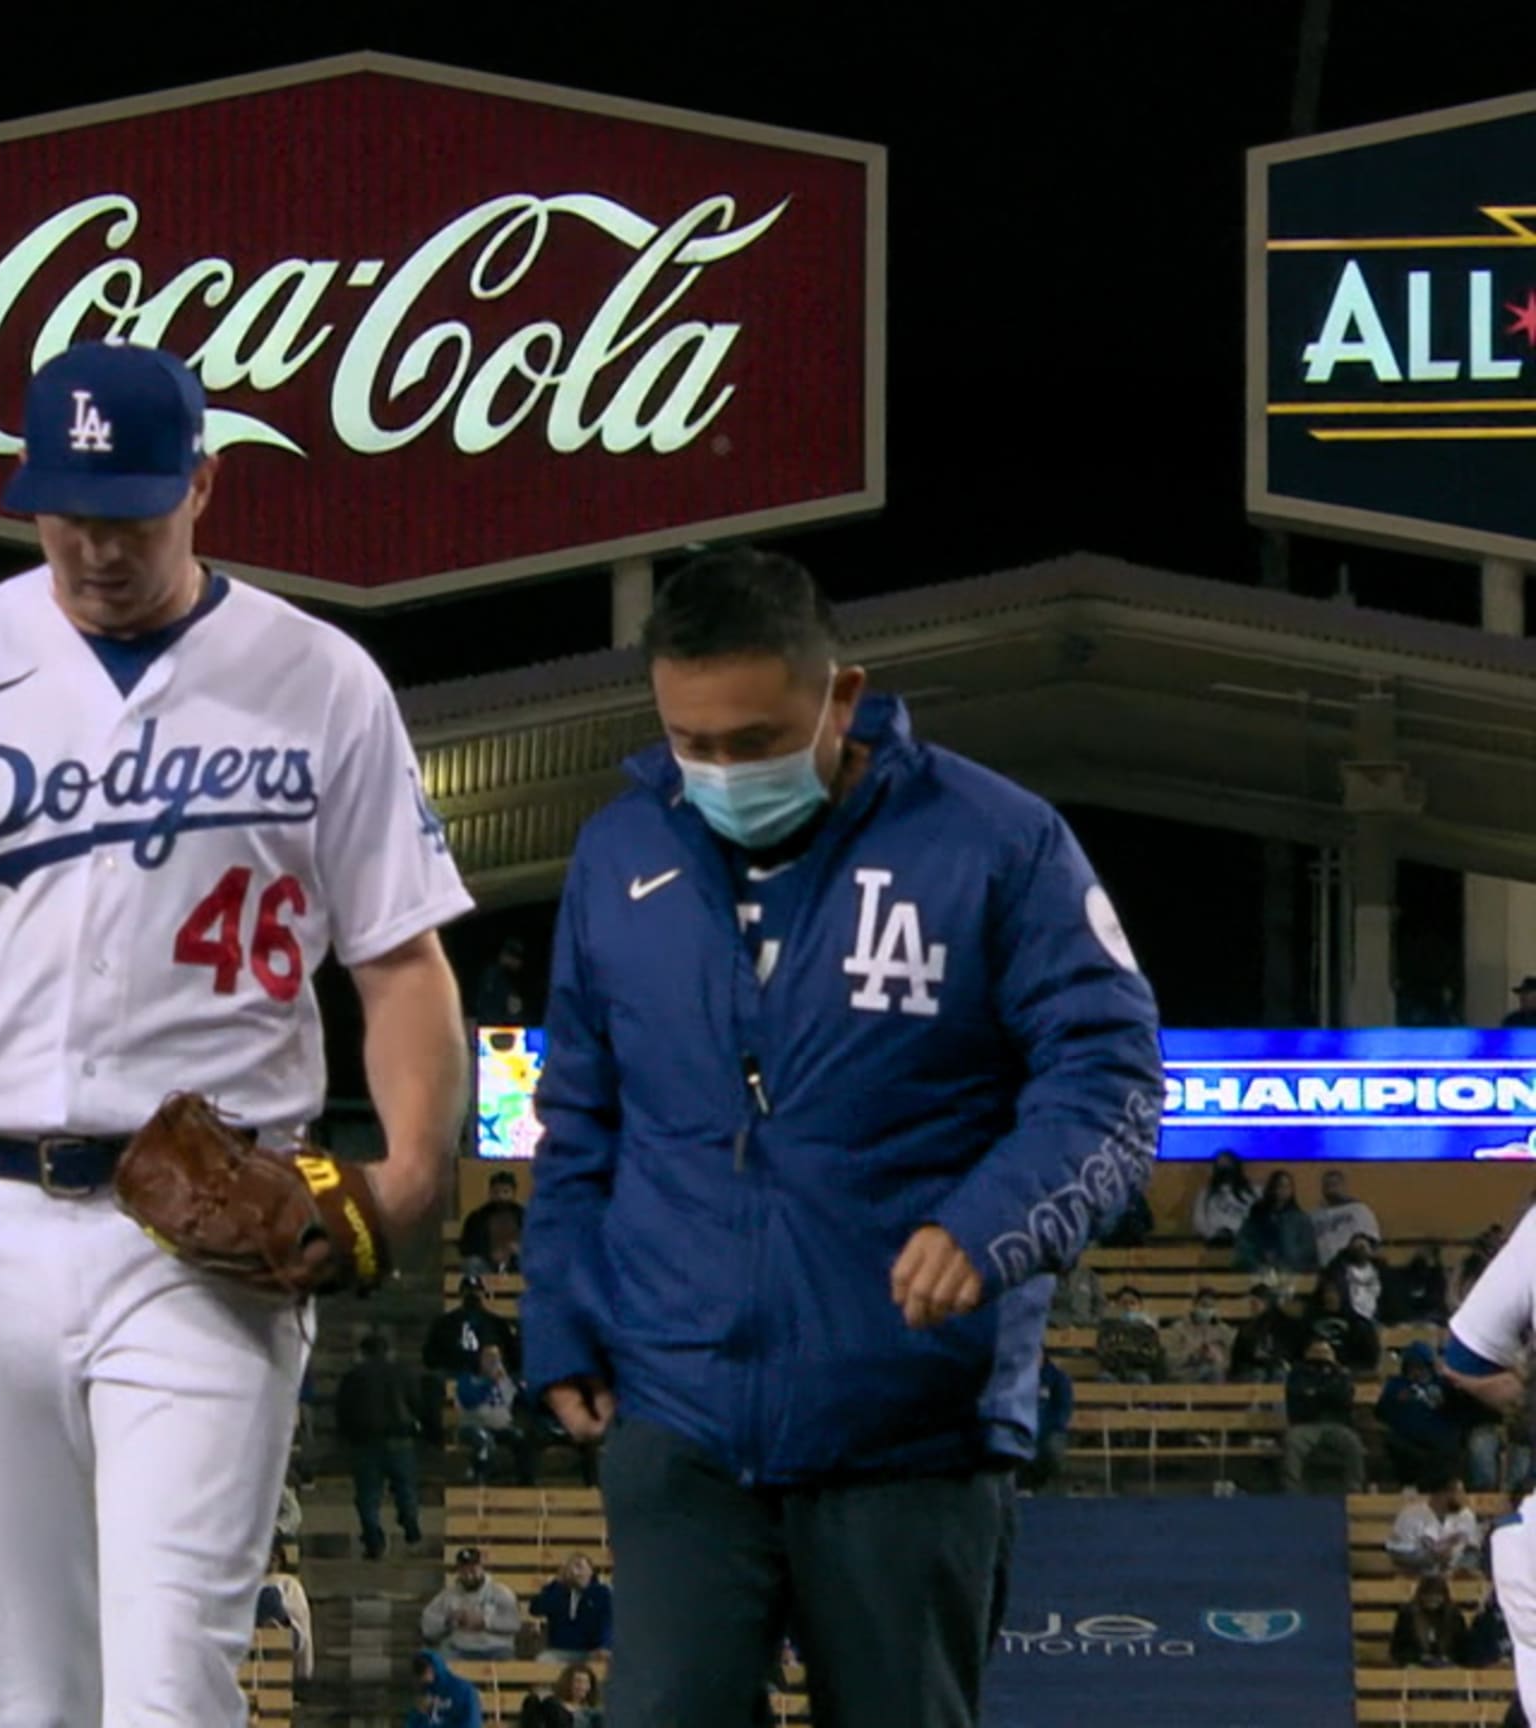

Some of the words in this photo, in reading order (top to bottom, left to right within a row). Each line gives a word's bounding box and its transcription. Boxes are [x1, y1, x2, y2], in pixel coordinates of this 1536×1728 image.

[1302, 258, 1522, 382] ALL
[69, 391, 113, 451] LA
[173, 866, 306, 1002] 46
[843, 869, 946, 1016] LA
